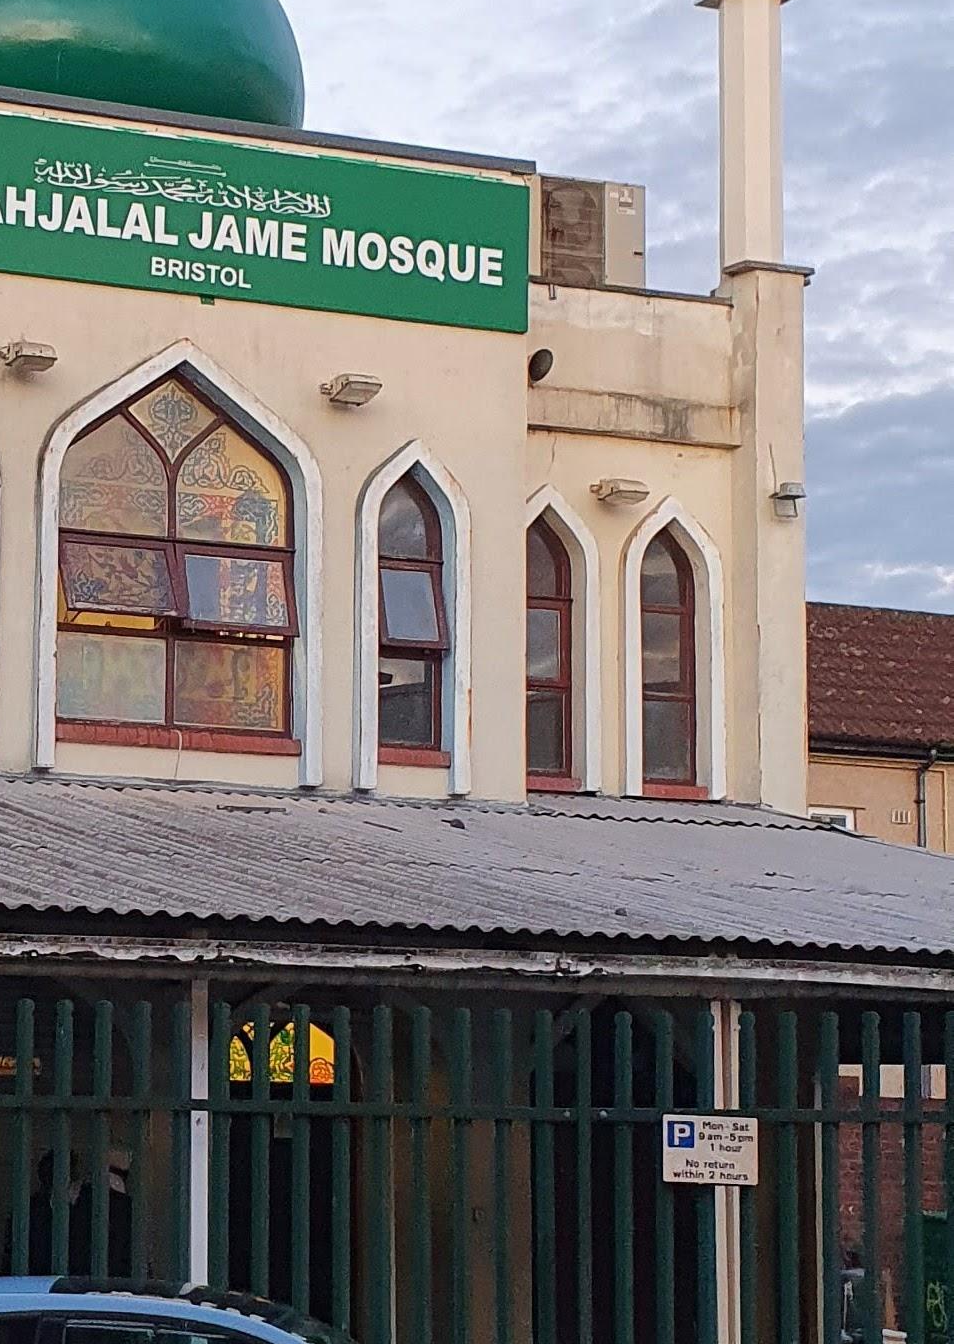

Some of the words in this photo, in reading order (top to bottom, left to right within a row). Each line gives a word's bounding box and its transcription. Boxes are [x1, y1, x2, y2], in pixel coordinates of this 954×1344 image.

[188, 211, 308, 262] JAME
[321, 227, 504, 287] MOSQUE
[150, 256, 252, 289] BRISTOL
[702, 1121, 724, 1131] Mon
[732, 1122, 750, 1132] Sat
[673, 1123, 691, 1146] P
[719, 1143, 742, 1153] hour
[685, 1158, 700, 1168] No
[703, 1160, 735, 1170] return
[672, 1170, 705, 1179] within
[708, 1170, 715, 1179] 2
[719, 1171, 748, 1181] hours
